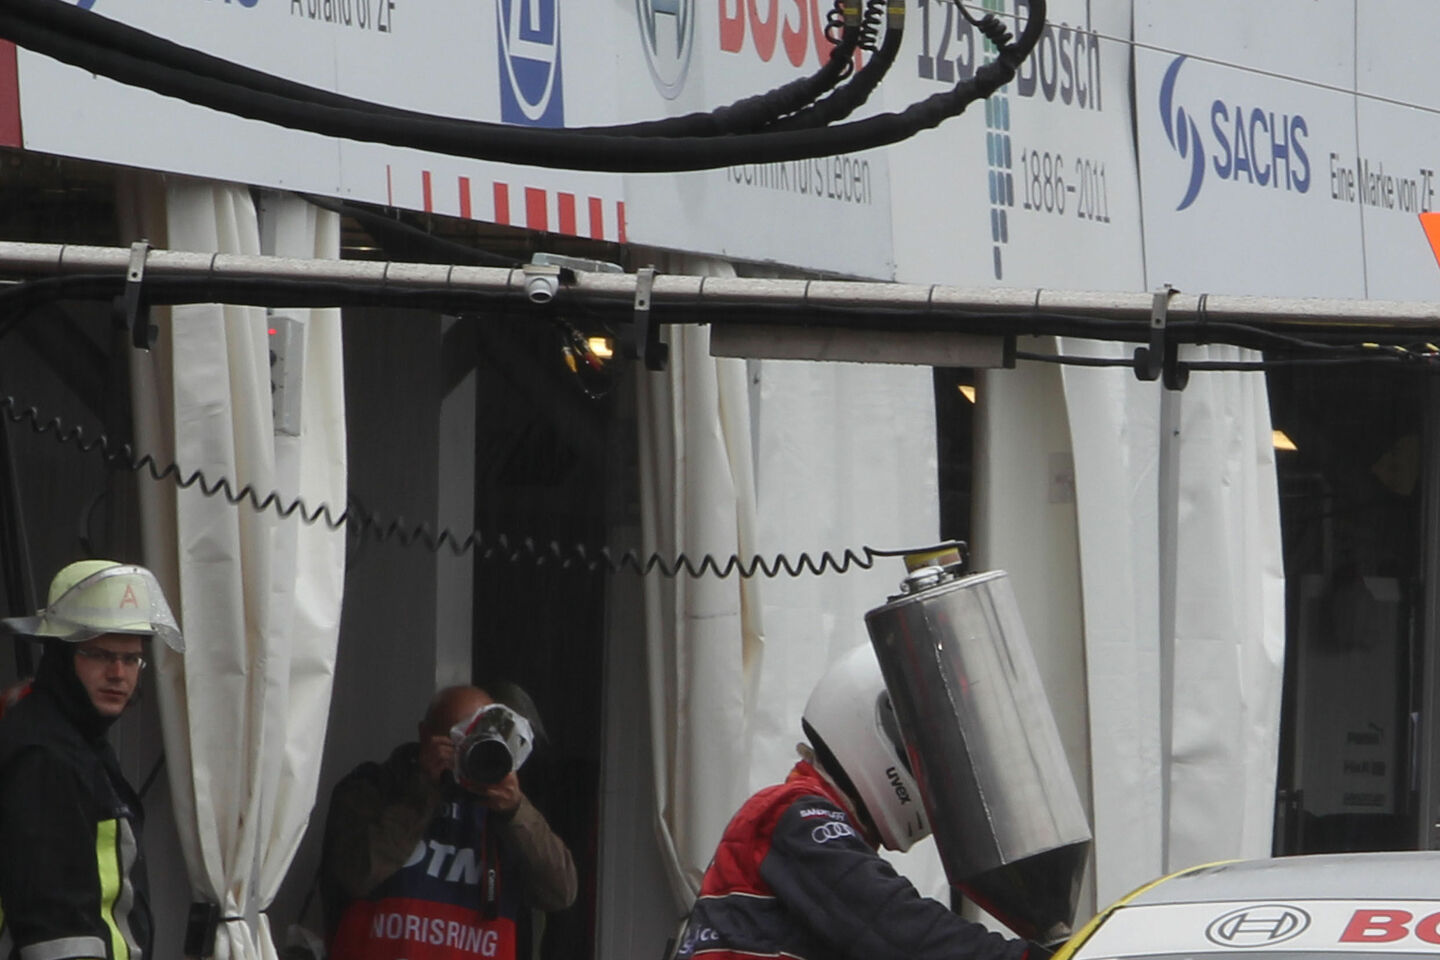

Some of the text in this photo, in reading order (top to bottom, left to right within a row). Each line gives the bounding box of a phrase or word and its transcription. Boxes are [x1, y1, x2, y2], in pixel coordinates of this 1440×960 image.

[1211, 99, 1311, 194] SACHS
[1021, 148, 1111, 224] 1886-2011
[1330, 152, 1435, 213] Eine Marke von ZF
[119, 584, 138, 609] A
[886, 766, 912, 805] uvex
[370, 913, 498, 957] NORISRING
